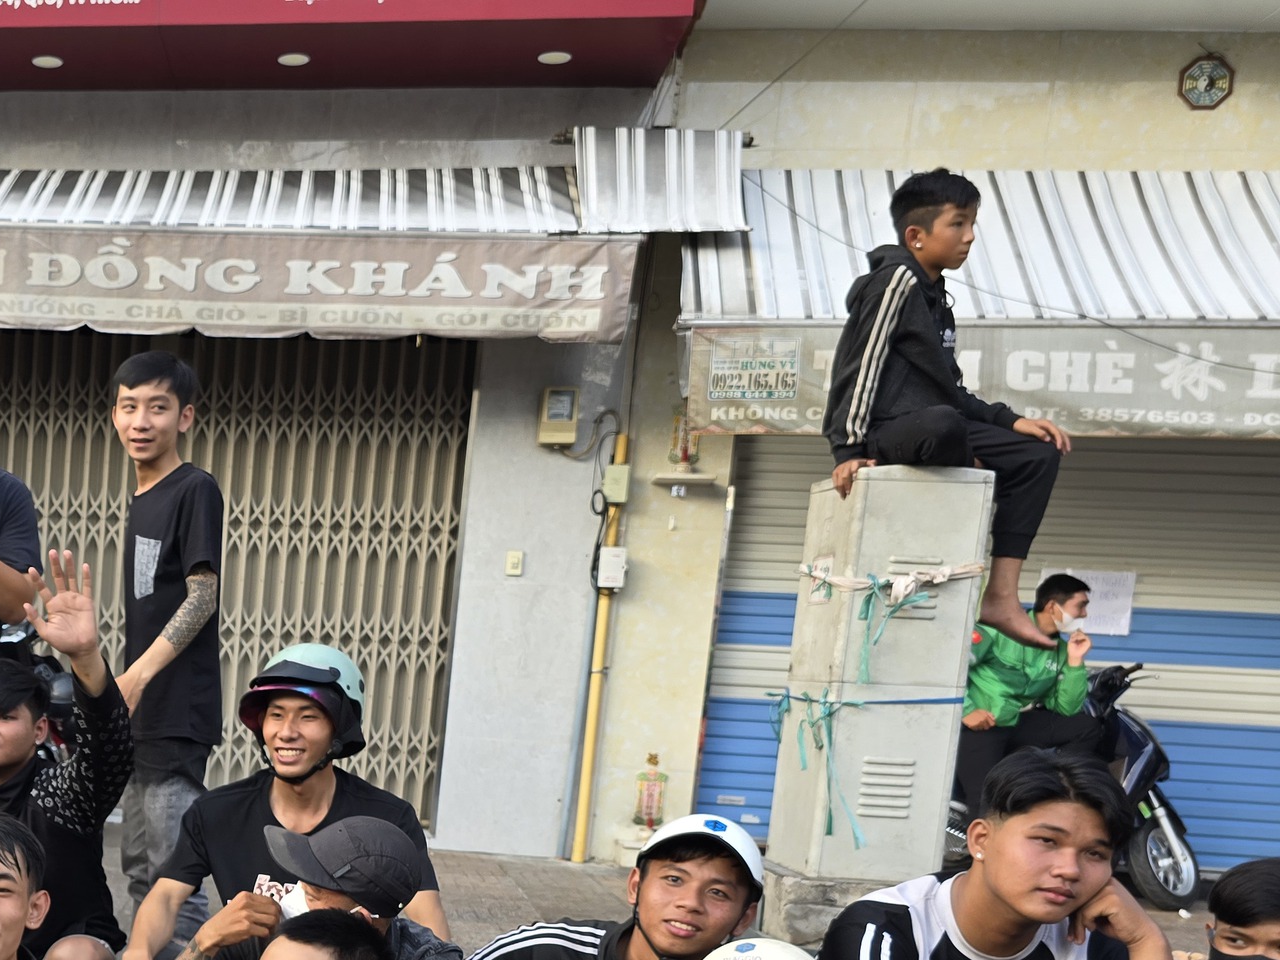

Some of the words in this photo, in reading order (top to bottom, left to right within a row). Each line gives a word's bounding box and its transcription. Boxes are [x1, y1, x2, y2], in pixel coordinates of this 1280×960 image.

[26, 236, 262, 294] ĐỒNG
[284, 252, 609, 300] KHÁNH
[195, 305, 246, 321] GIÒ
[278, 306, 308, 323] BÌ
[1006, 340, 1135, 394] CHÈ
[712, 371, 797, 391] 0922.165.165
[710, 403, 798, 421] KHÔNG
[1078, 406, 1215, 424] 38576503
